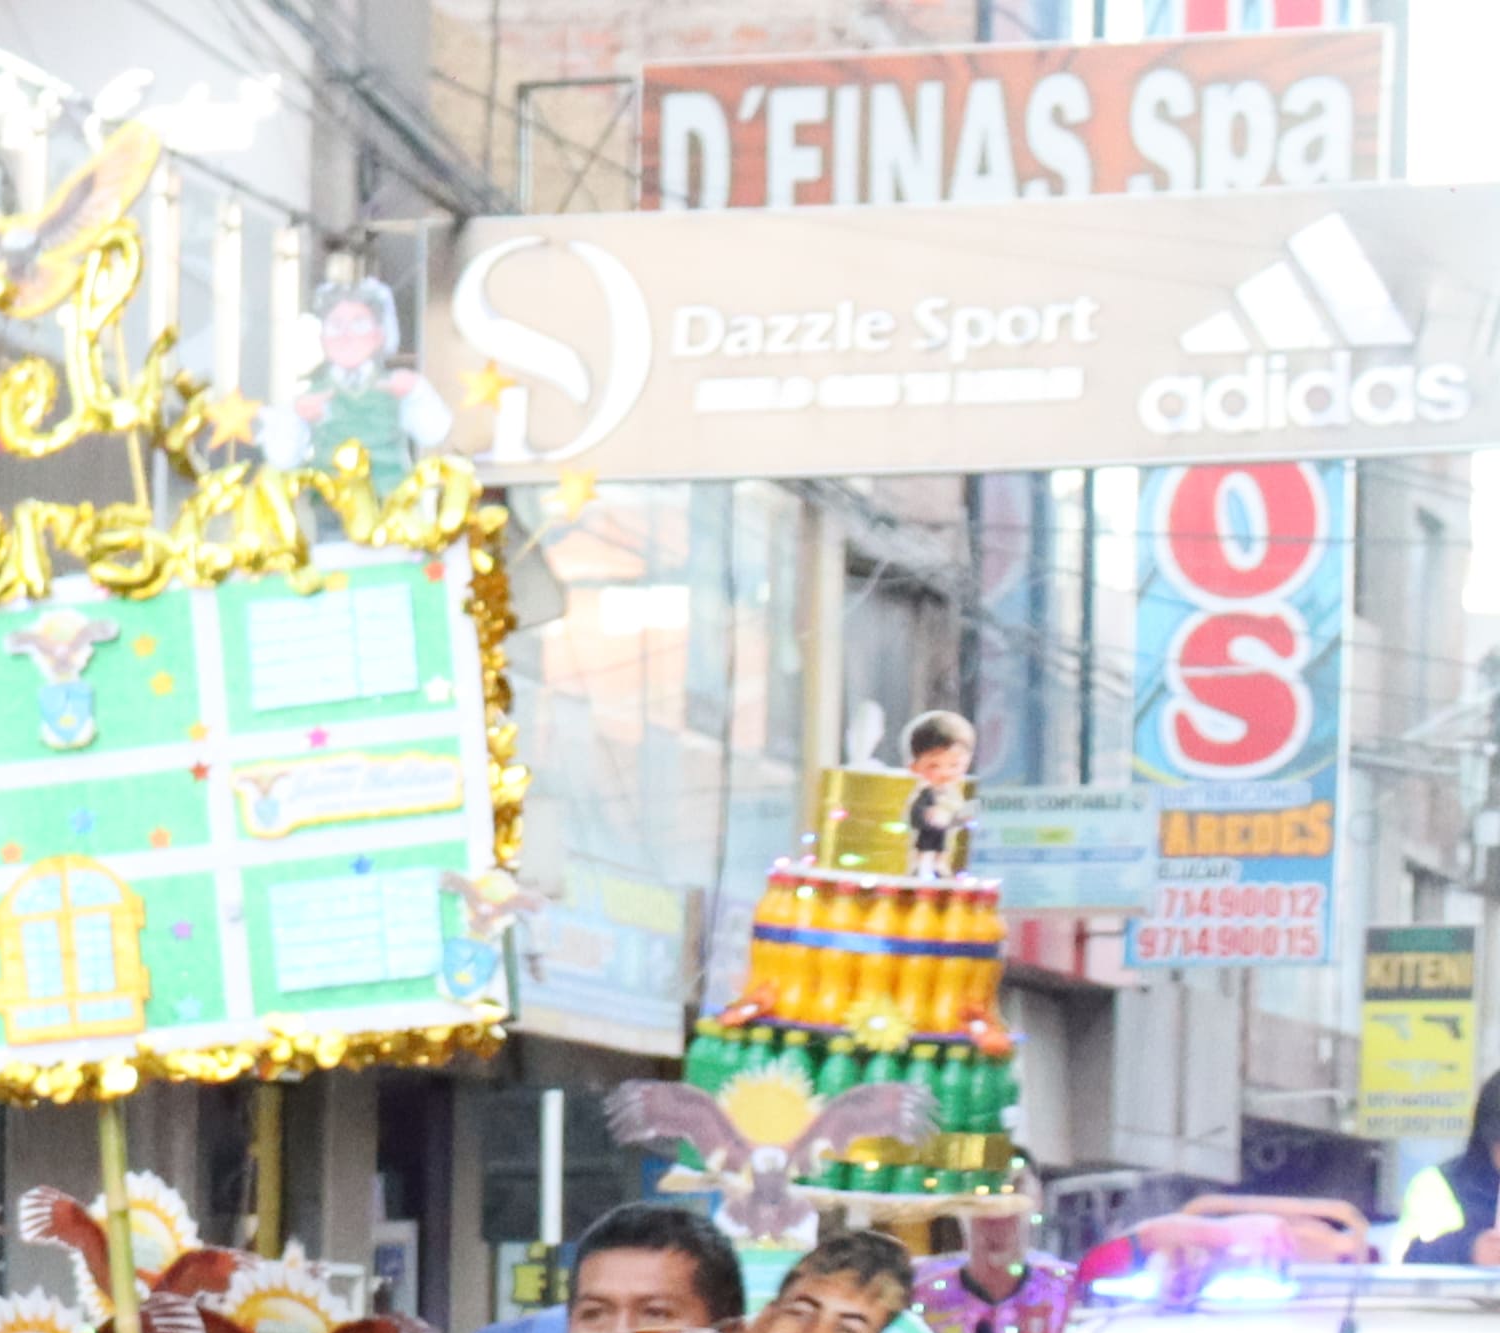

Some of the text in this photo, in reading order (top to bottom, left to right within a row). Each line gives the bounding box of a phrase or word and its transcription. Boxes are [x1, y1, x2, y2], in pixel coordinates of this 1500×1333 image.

[1126, 71, 1355, 194] Spa
[671, 294, 1100, 367] Dazzle Sport
[1137, 349, 1472, 434] adidas
